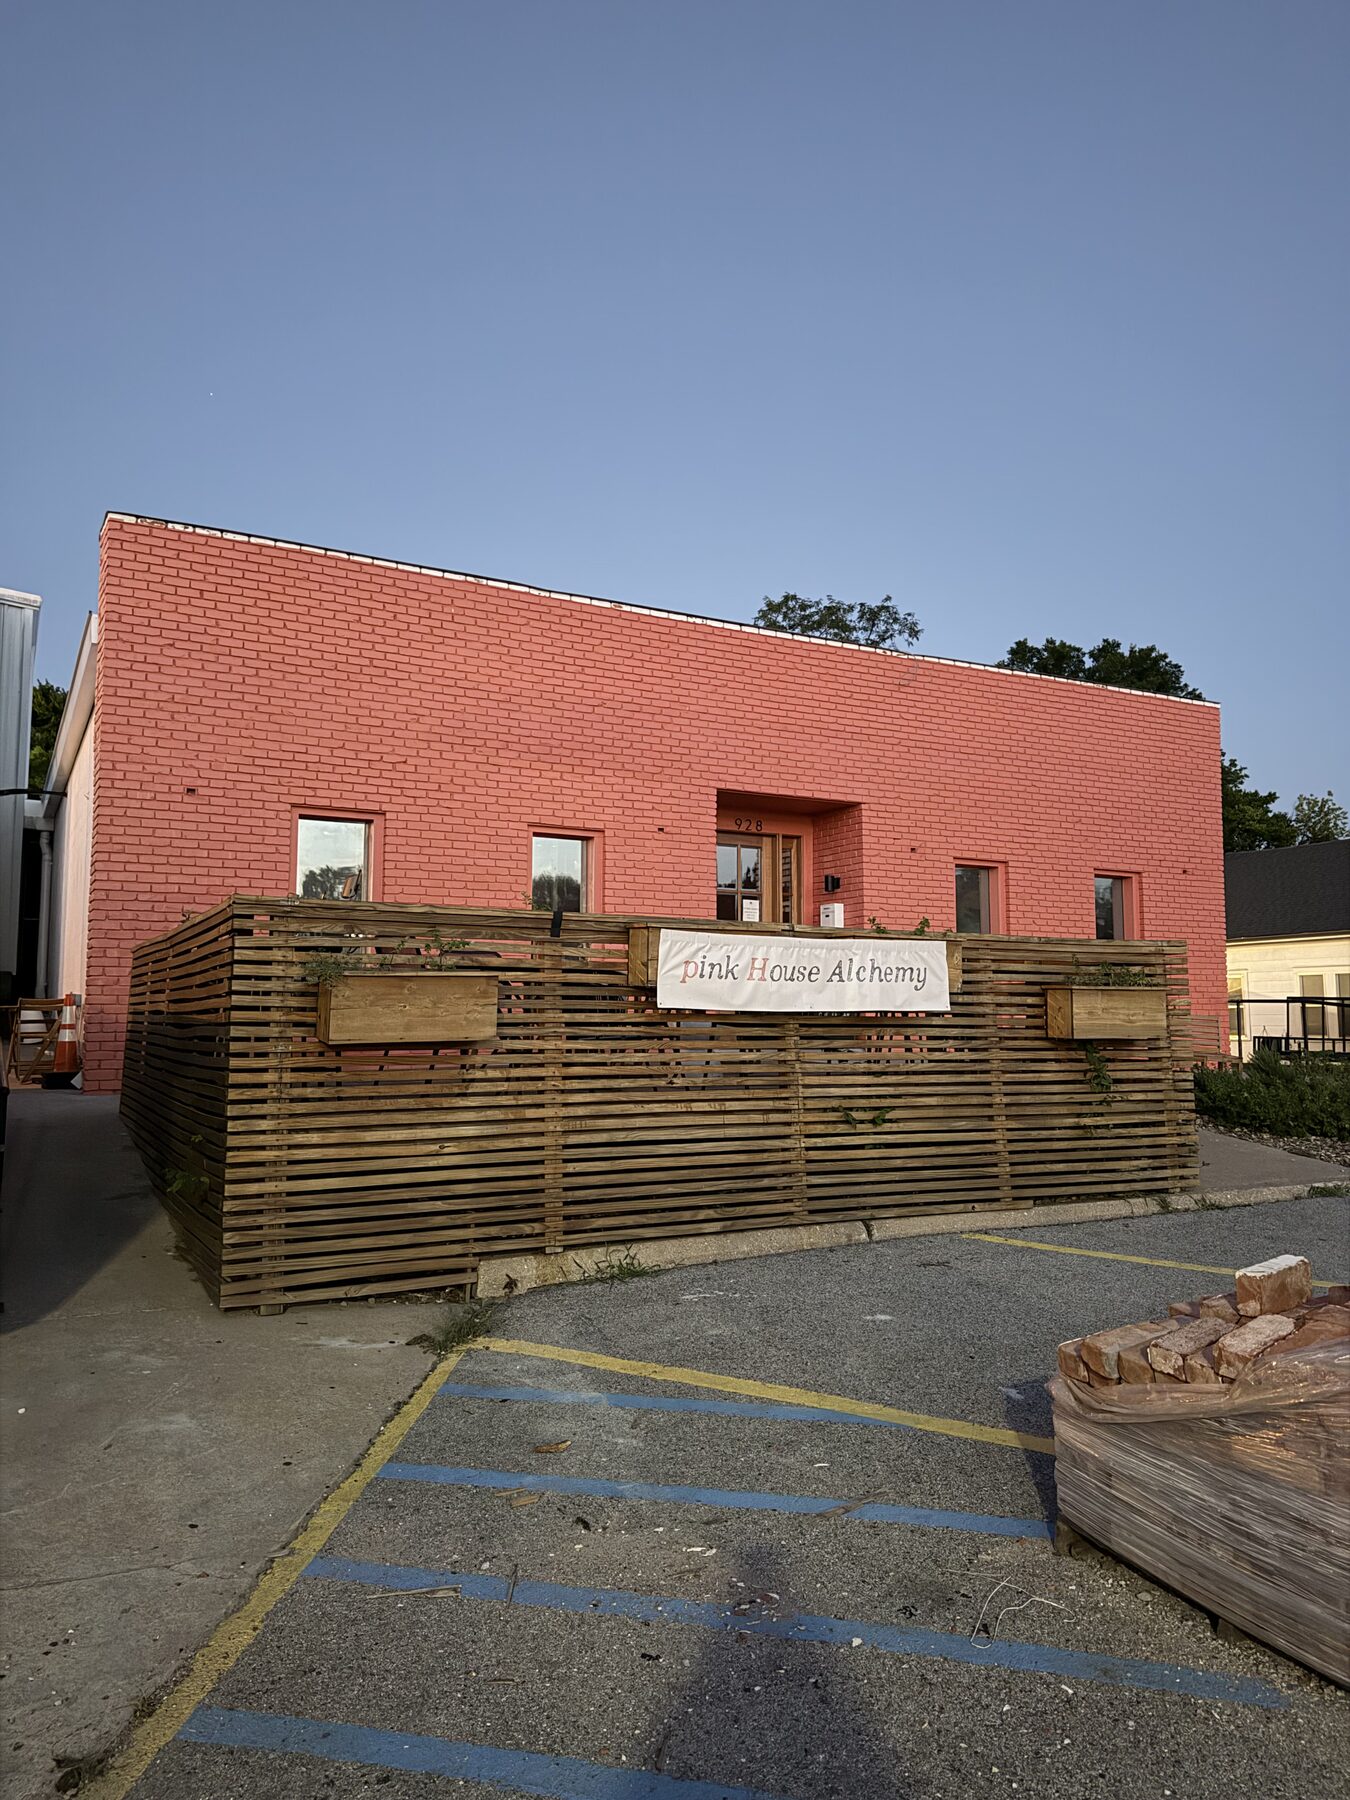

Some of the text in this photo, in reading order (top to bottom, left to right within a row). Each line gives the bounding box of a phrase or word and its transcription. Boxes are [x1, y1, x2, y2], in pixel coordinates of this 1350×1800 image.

[734, 817, 763, 832] 928
[680, 954, 927, 991] pink House Alchemy
